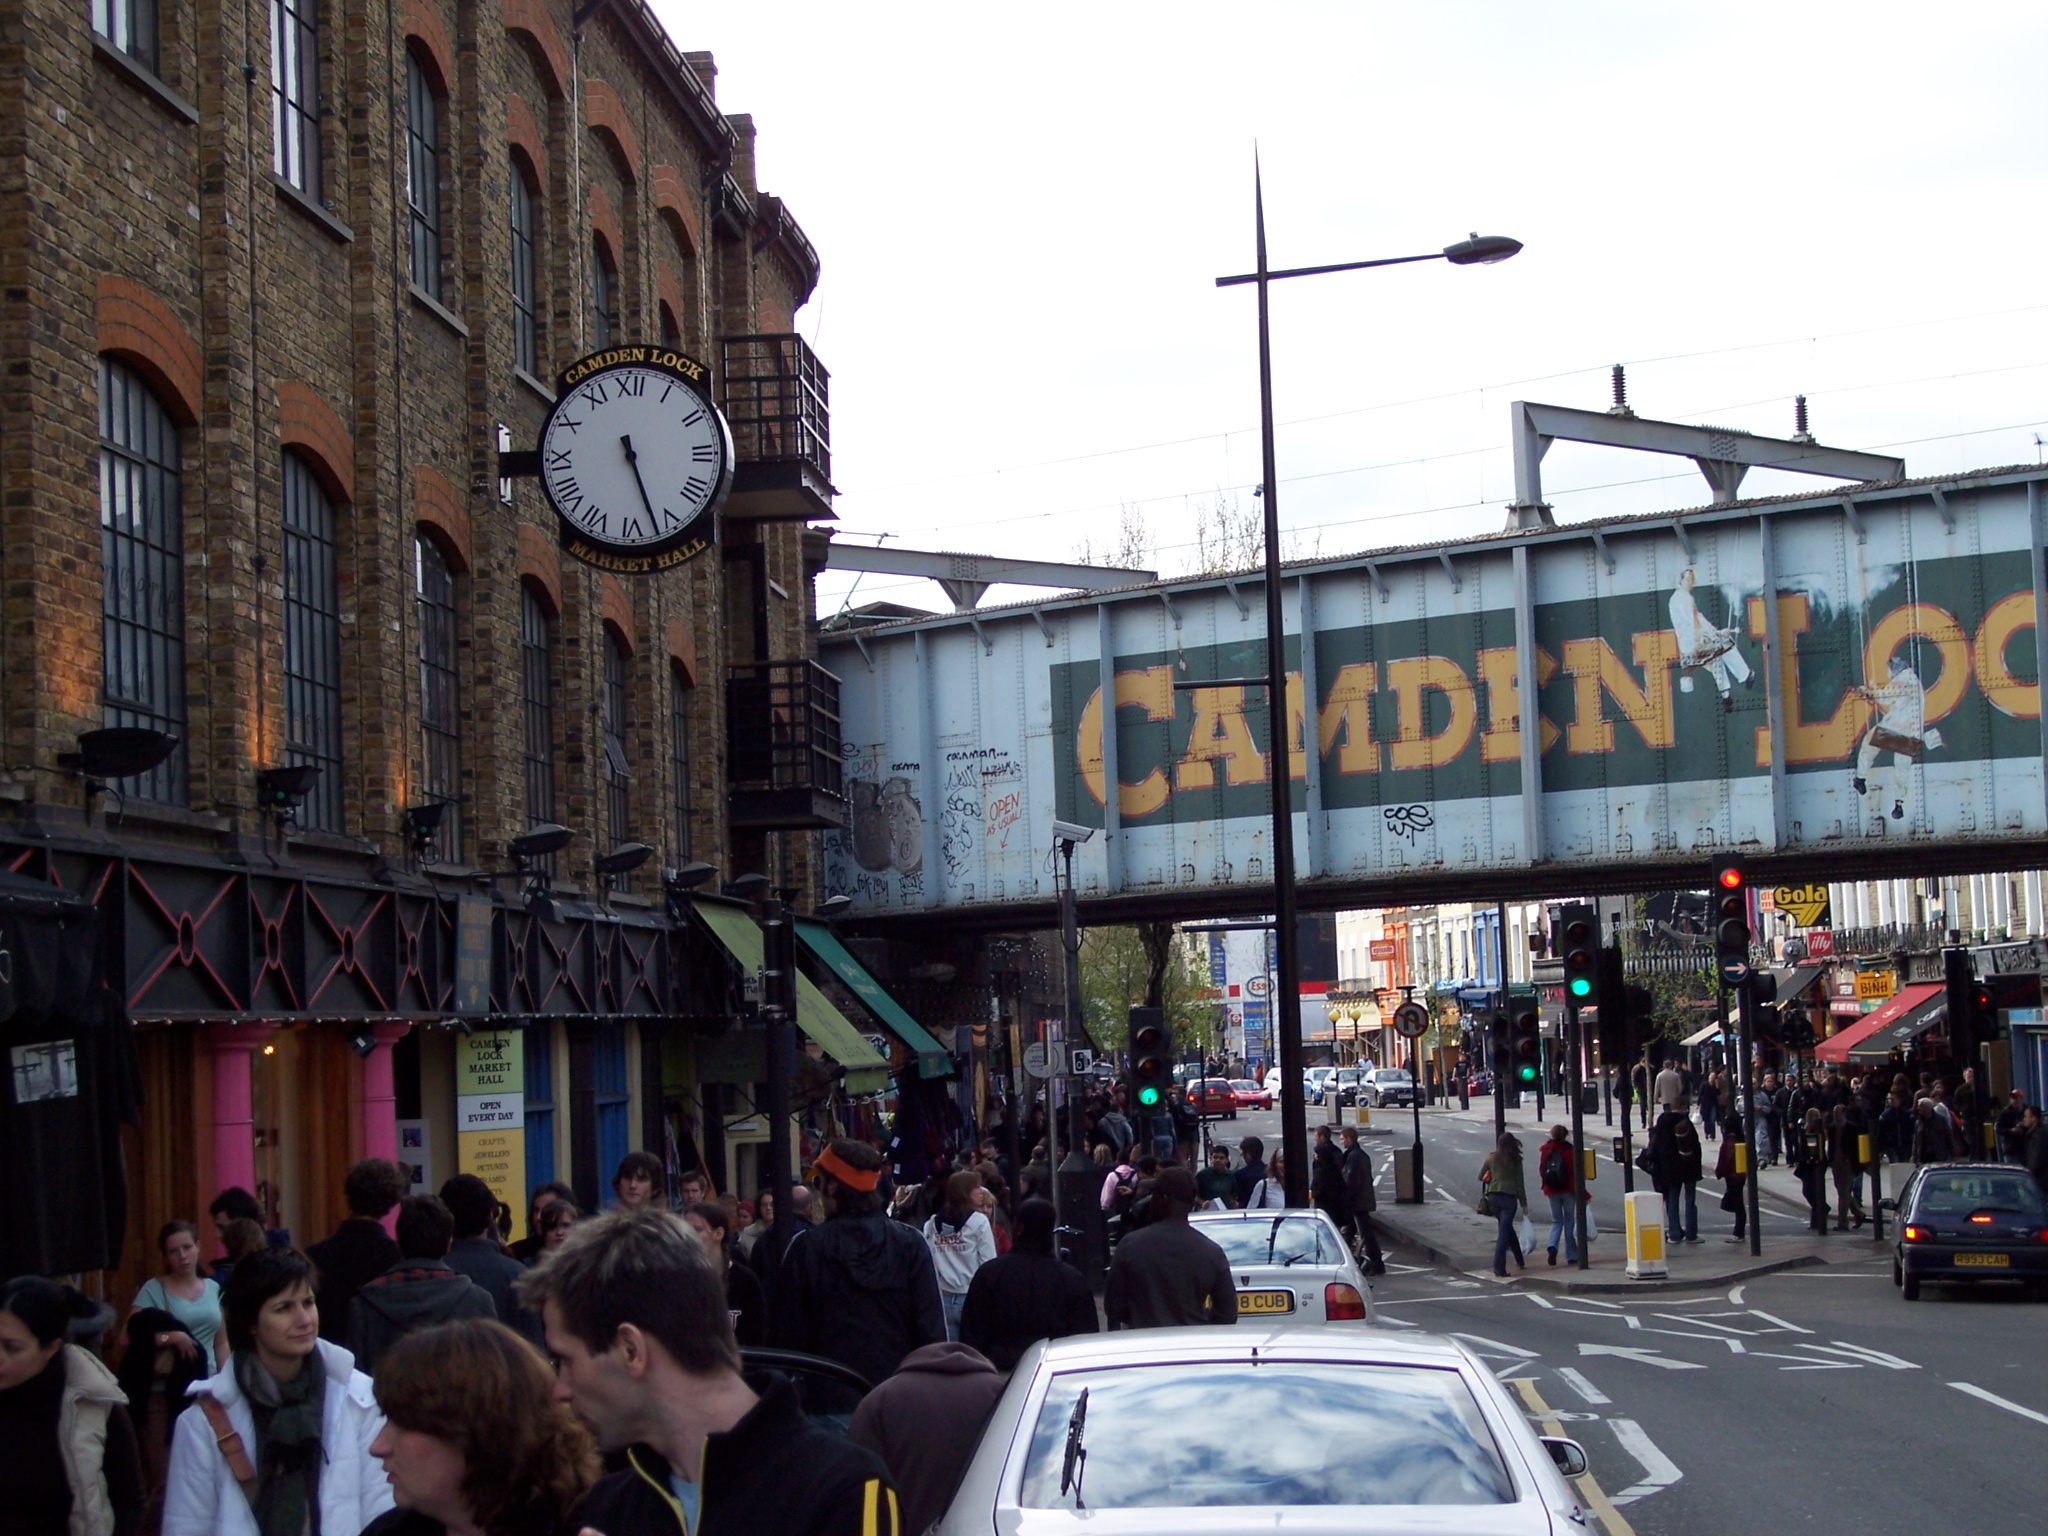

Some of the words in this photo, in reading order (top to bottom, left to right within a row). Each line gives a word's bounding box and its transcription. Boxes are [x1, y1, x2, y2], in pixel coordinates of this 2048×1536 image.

[565, 348, 645, 384] CAMDEN
[650, 350, 704, 381] LOCK
[614, 376, 645, 397] XII
[660, 385, 672, 403] I
[581, 383, 609, 411] XI
[558, 414, 582, 435] X
[682, 409, 703, 428] II
[551, 449, 572, 471] IX
[692, 444, 713, 462] III
[555, 477, 584, 513] VIII
[581, 504, 607, 533] VII
[622, 517, 644, 537] VI
[664, 508, 681, 529] V
[569, 541, 652, 572] MARKET
[657, 538, 707, 566] HALL
[1076, 629, 1683, 819] CAMDEN
[989, 791, 1020, 821] OPEN
[1774, 884, 1828, 904] Gola
[1810, 935, 1831, 951] illy
[477, 1051, 503, 1060] LOCK
[469, 1062, 512, 1073] MARKET
[478, 1075, 504, 1085] HALL
[480, 1102, 501, 1110] OPEN
[468, 1113, 495, 1123] EVERY
[498, 1112, 514, 1121] DAY
[1254, 1294, 1286, 1308] CUB
